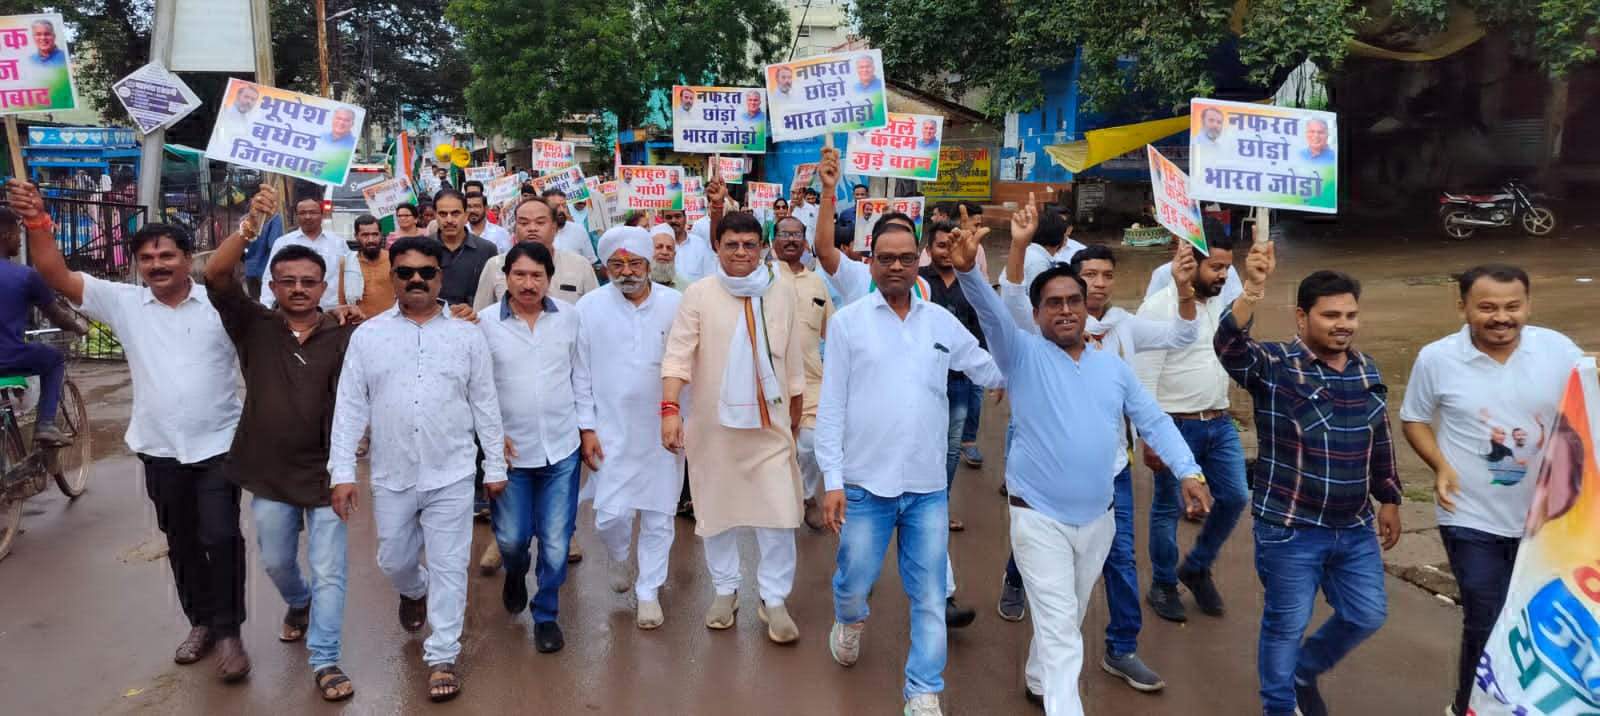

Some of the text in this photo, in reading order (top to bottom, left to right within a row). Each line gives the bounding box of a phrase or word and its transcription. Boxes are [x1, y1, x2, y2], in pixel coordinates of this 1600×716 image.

[795, 59, 851, 80] नफरत
[696, 91, 742, 105] नफरत
[805, 77, 847, 101] छोड़ो
[260, 96, 330, 125] भूपेश
[703, 105, 736, 125] छोड़ो
[784, 99, 874, 130] भारत जोड़ो
[1228, 111, 1300, 136] नफरत
[252, 122, 320, 151] बघेल
[682, 126, 757, 149] भारत जोड़ो
[870, 134, 917, 150] कदम
[230, 138, 328, 177] जिंदाबाद
[852, 149, 933, 170] जुड़े वतन
[1237, 134, 1292, 165] छोड़ो
[634, 167, 667, 183] राहुल
[1205, 168, 1324, 203] भारत जोड़ो
[635, 183, 666, 197] गांधी
[628, 194, 673, 210] जिंदाबाद
